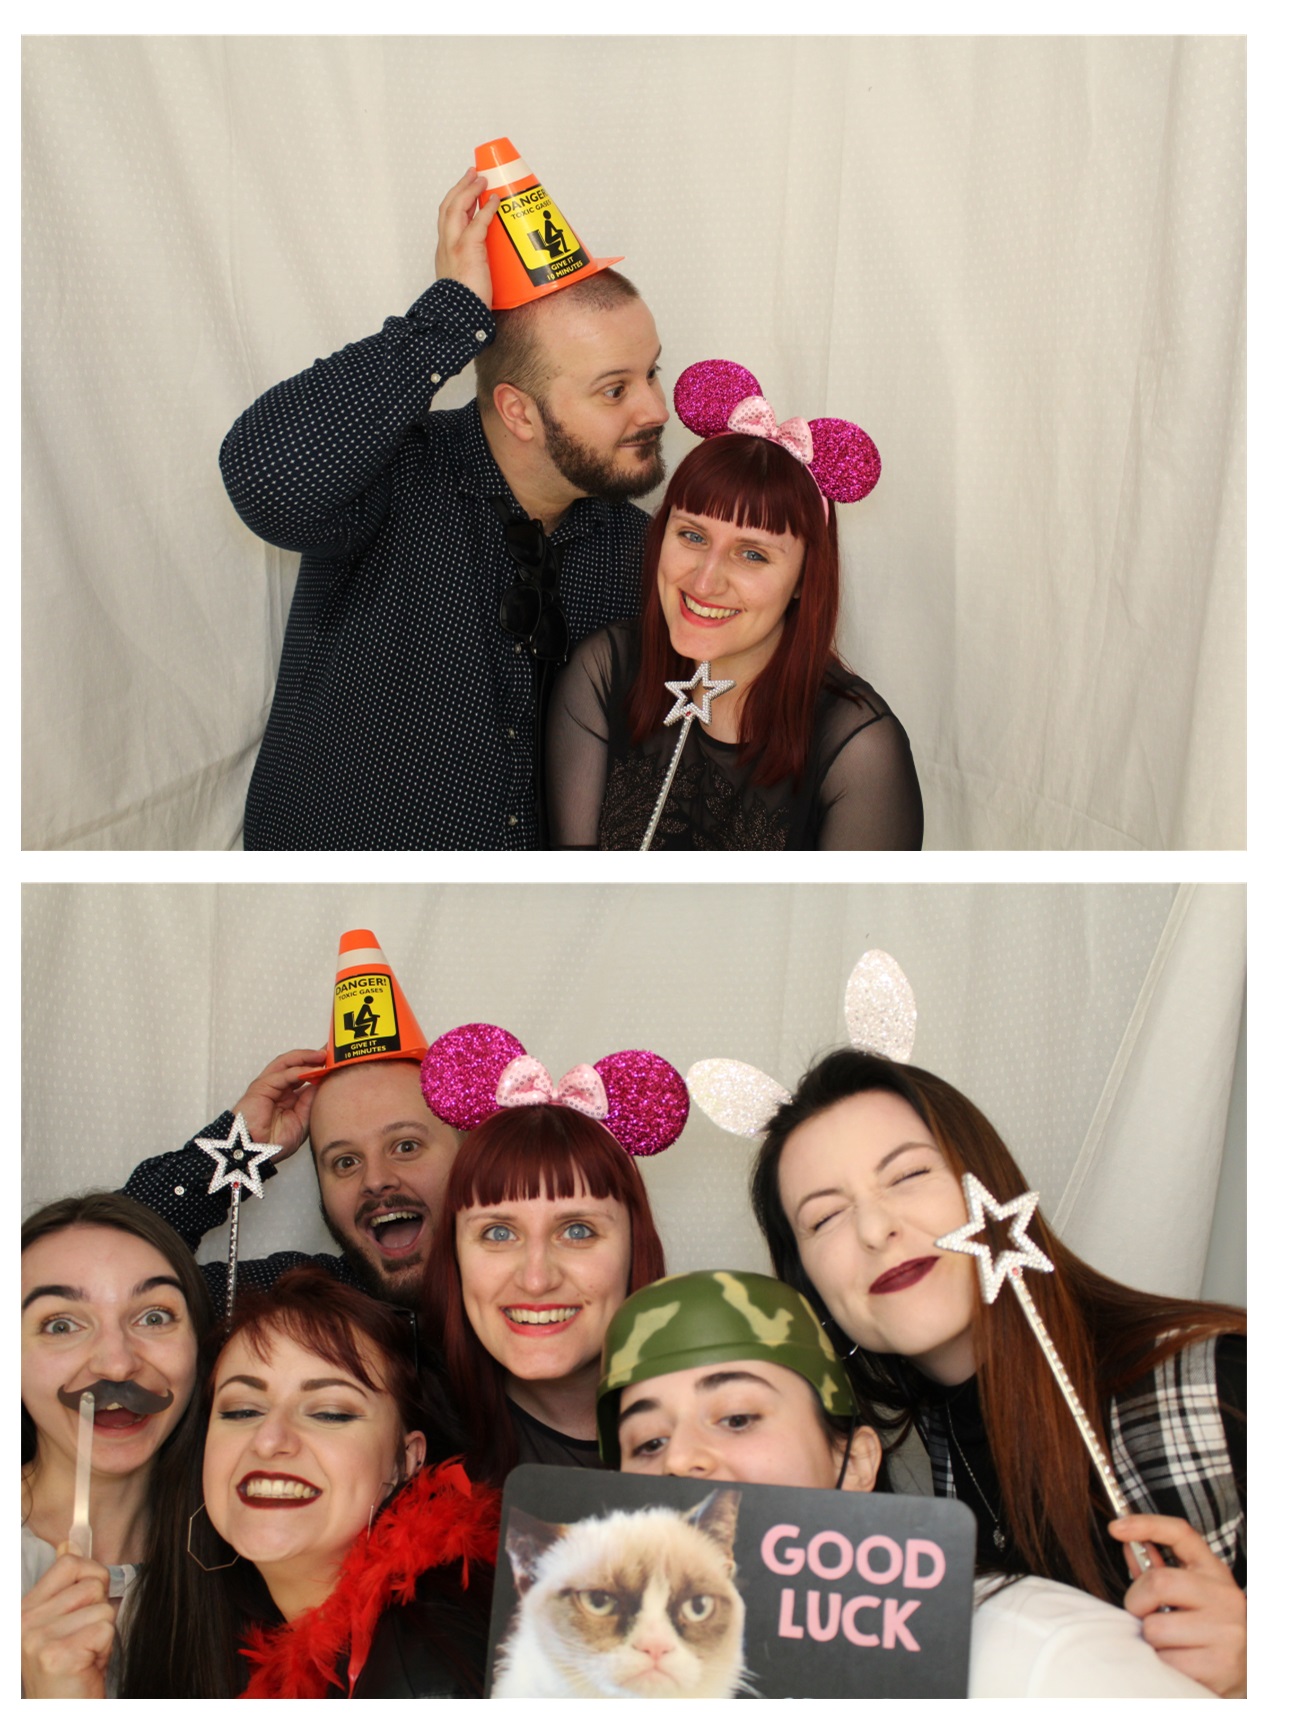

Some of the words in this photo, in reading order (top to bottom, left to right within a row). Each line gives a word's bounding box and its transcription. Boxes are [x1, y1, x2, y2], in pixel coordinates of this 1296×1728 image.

[511, 207, 534, 220] TOXIC
[535, 199, 552, 210] GASES
[551, 260, 568, 270] GIVE
[555, 260, 583, 277] MINUTES
[335, 978, 387, 996] DANGER!
[338, 991, 357, 1001] TOXIC
[359, 987, 384, 995] GASES
[350, 1042, 367, 1050] GIVE
[352, 1045, 387, 1057] MINUTES
[761, 1523, 946, 1590] GOOD
[778, 1588, 921, 1653] LUCK
